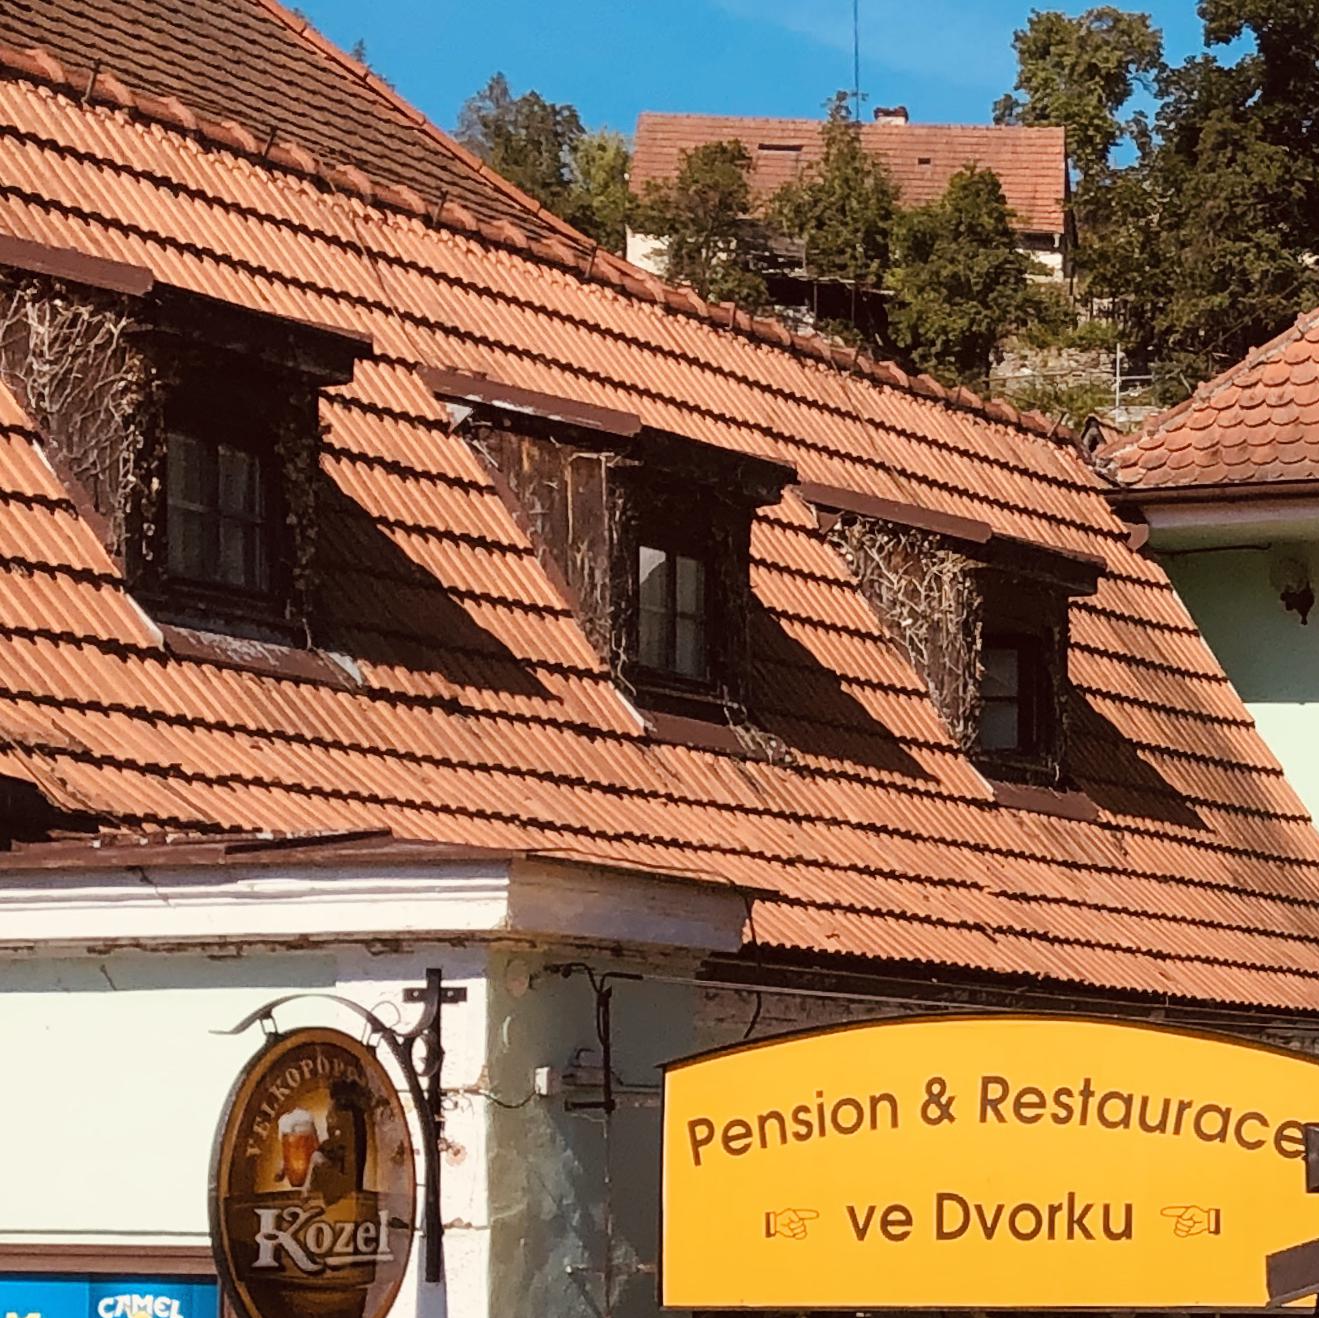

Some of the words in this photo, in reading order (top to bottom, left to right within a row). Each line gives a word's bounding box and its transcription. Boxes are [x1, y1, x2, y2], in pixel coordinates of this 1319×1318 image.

[687, 1089, 899, 1166] Pension
[920, 1076, 955, 1126] &
[979, 1074, 1307, 1160] Restaurace
[251, 1206, 394, 1275] Kozel
[847, 1203, 913, 1242] ve
[936, 1191, 1135, 1242] Dvorku
